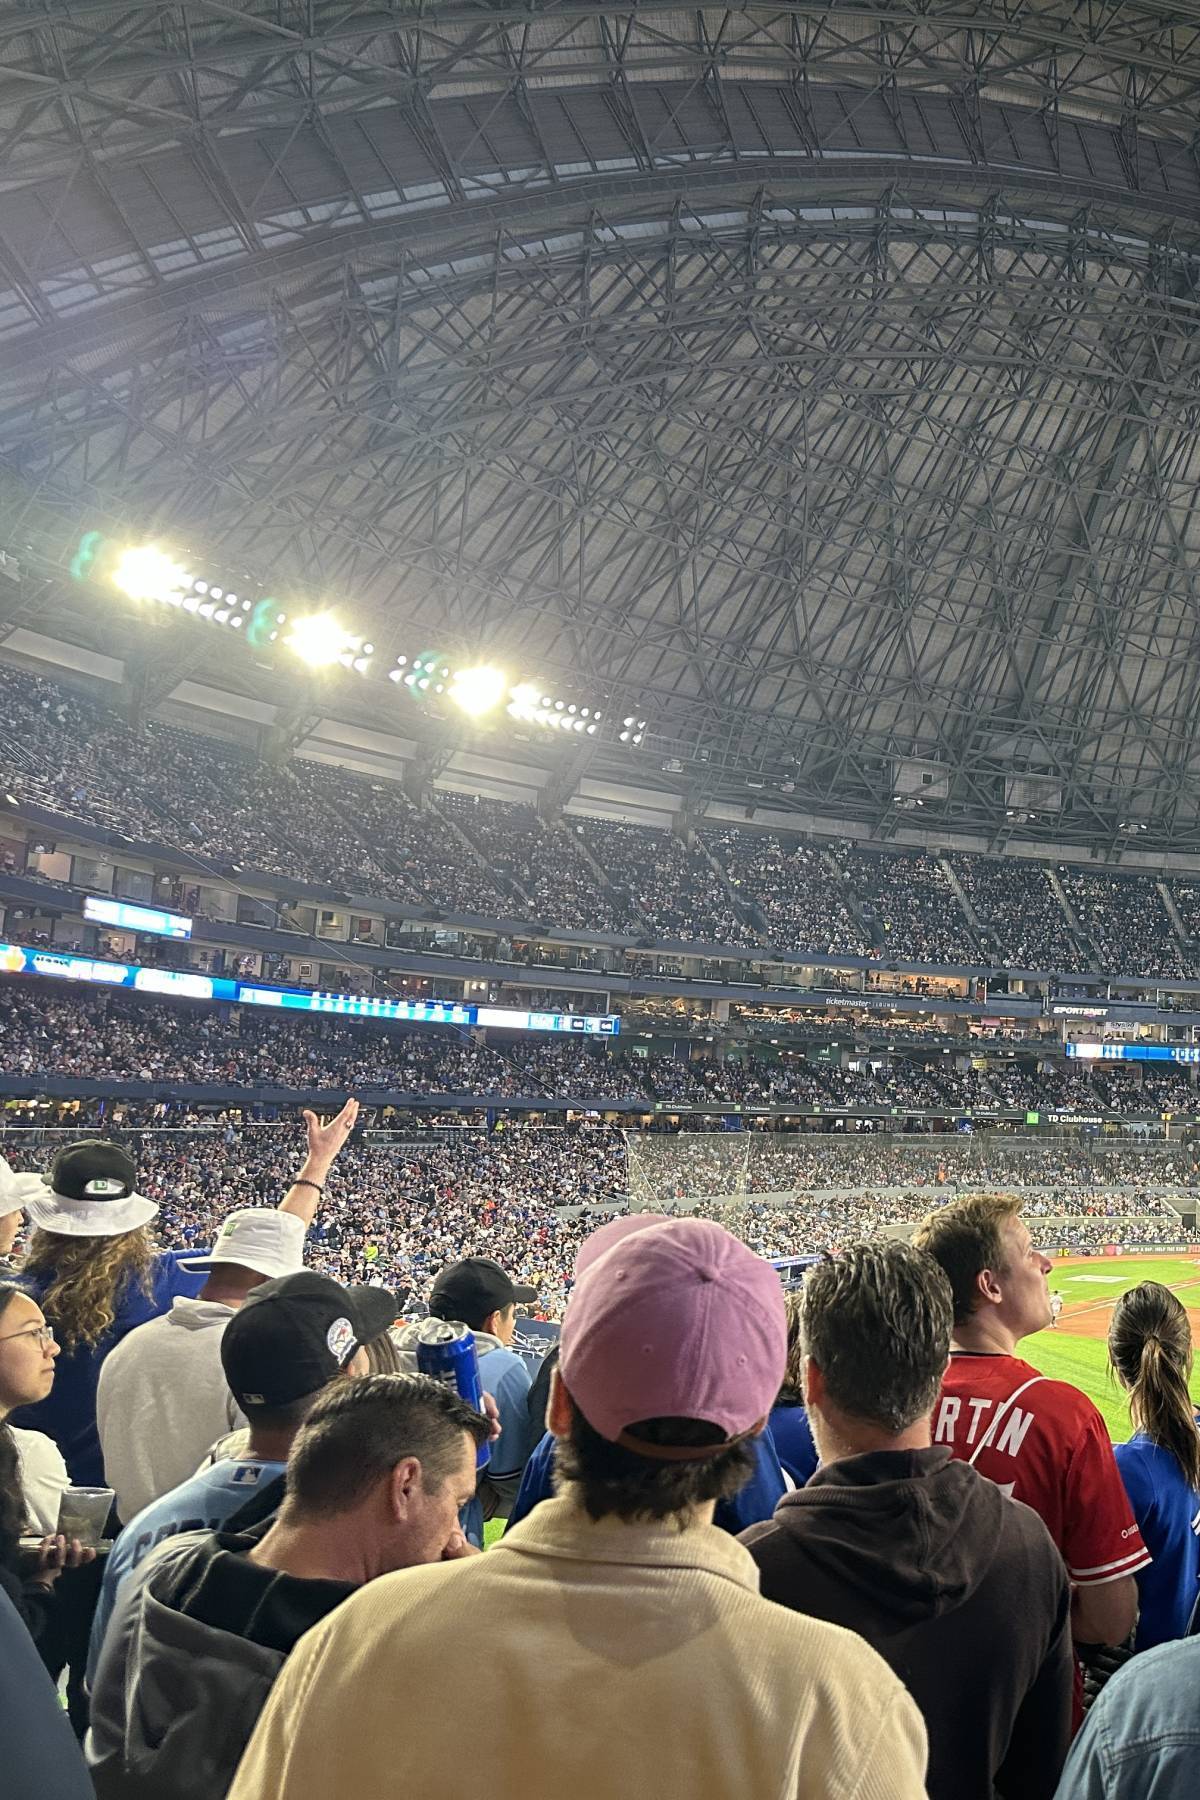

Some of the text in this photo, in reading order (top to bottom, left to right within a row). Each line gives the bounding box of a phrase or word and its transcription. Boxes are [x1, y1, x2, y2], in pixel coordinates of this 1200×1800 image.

[825, 996, 869, 1007] ticketmaster
[1053, 1007, 1108, 1016] SPORTSNET
[1048, 1114, 1102, 1123] TD Clubhouse
[935, 1397, 1034, 1457] RTIN
